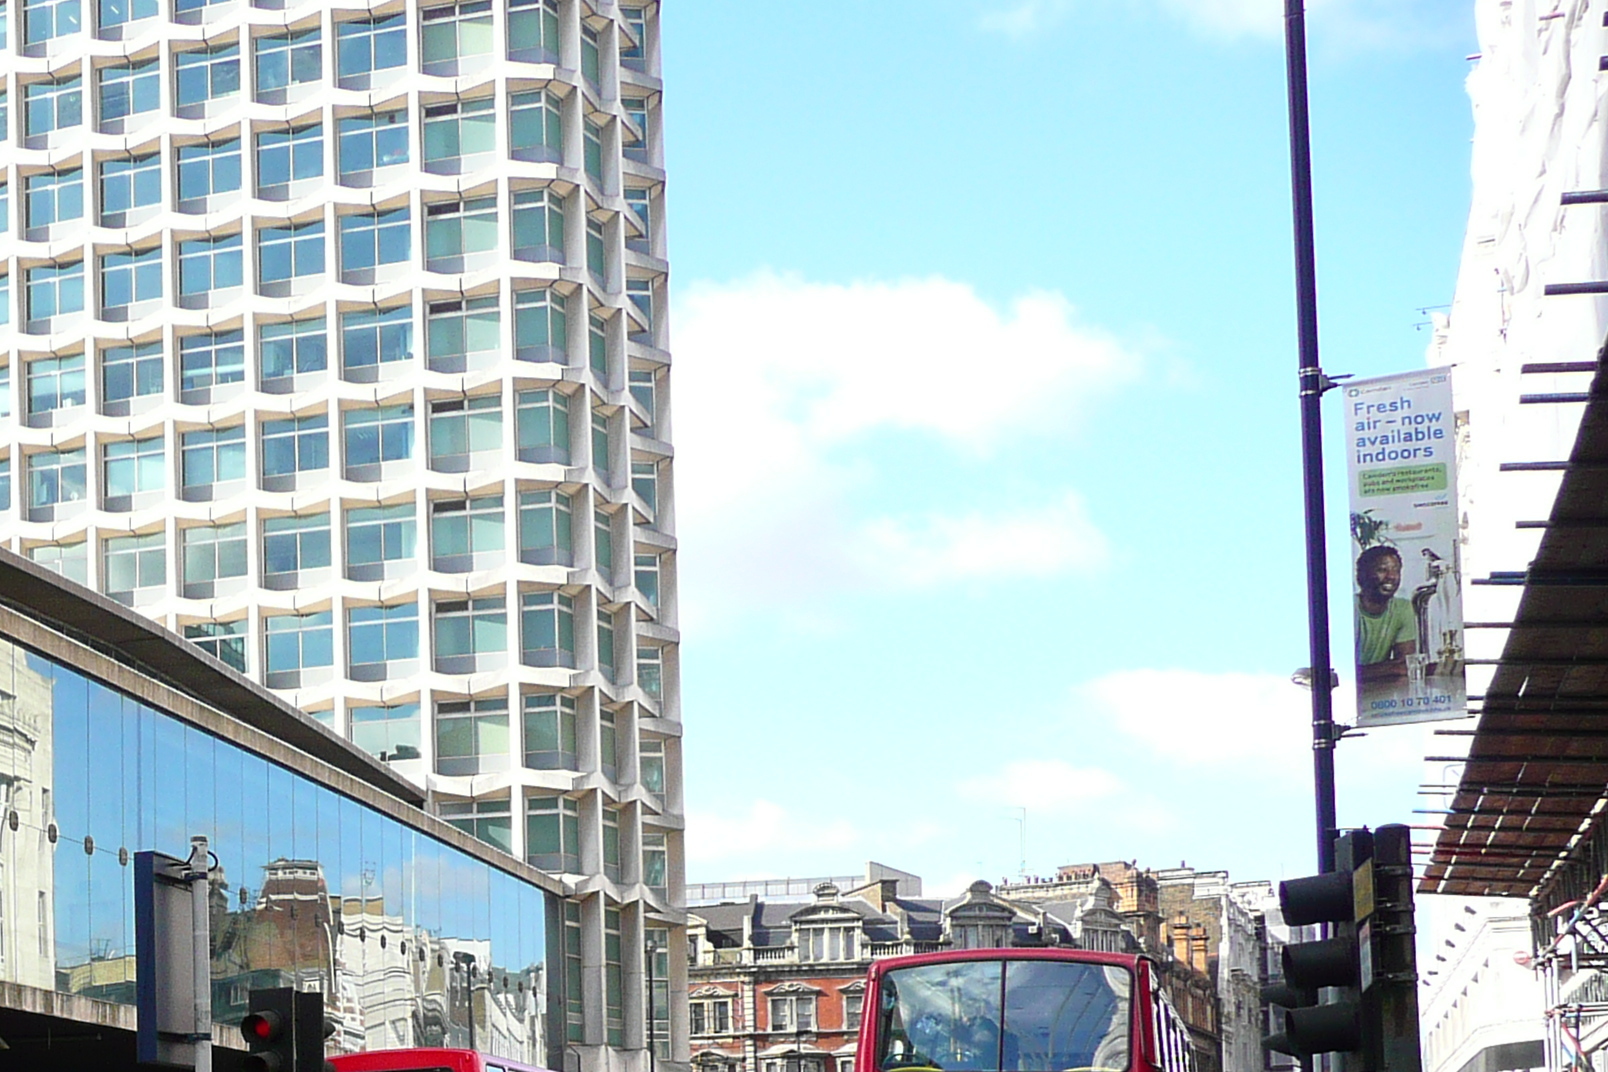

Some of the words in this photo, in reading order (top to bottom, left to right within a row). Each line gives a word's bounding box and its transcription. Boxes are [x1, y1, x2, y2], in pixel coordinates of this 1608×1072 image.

[1354, 396, 1411, 416] Fresh
[1355, 416, 1381, 432] air
[1401, 412, 1442, 426] now
[1356, 425, 1444, 447] available
[1357, 446, 1434, 464] indoors
[1371, 699, 1397, 710] 0800
[1401, 698, 1413, 707] 10
[1416, 696, 1430, 706] 70
[1433, 695, 1451, 704] 401
